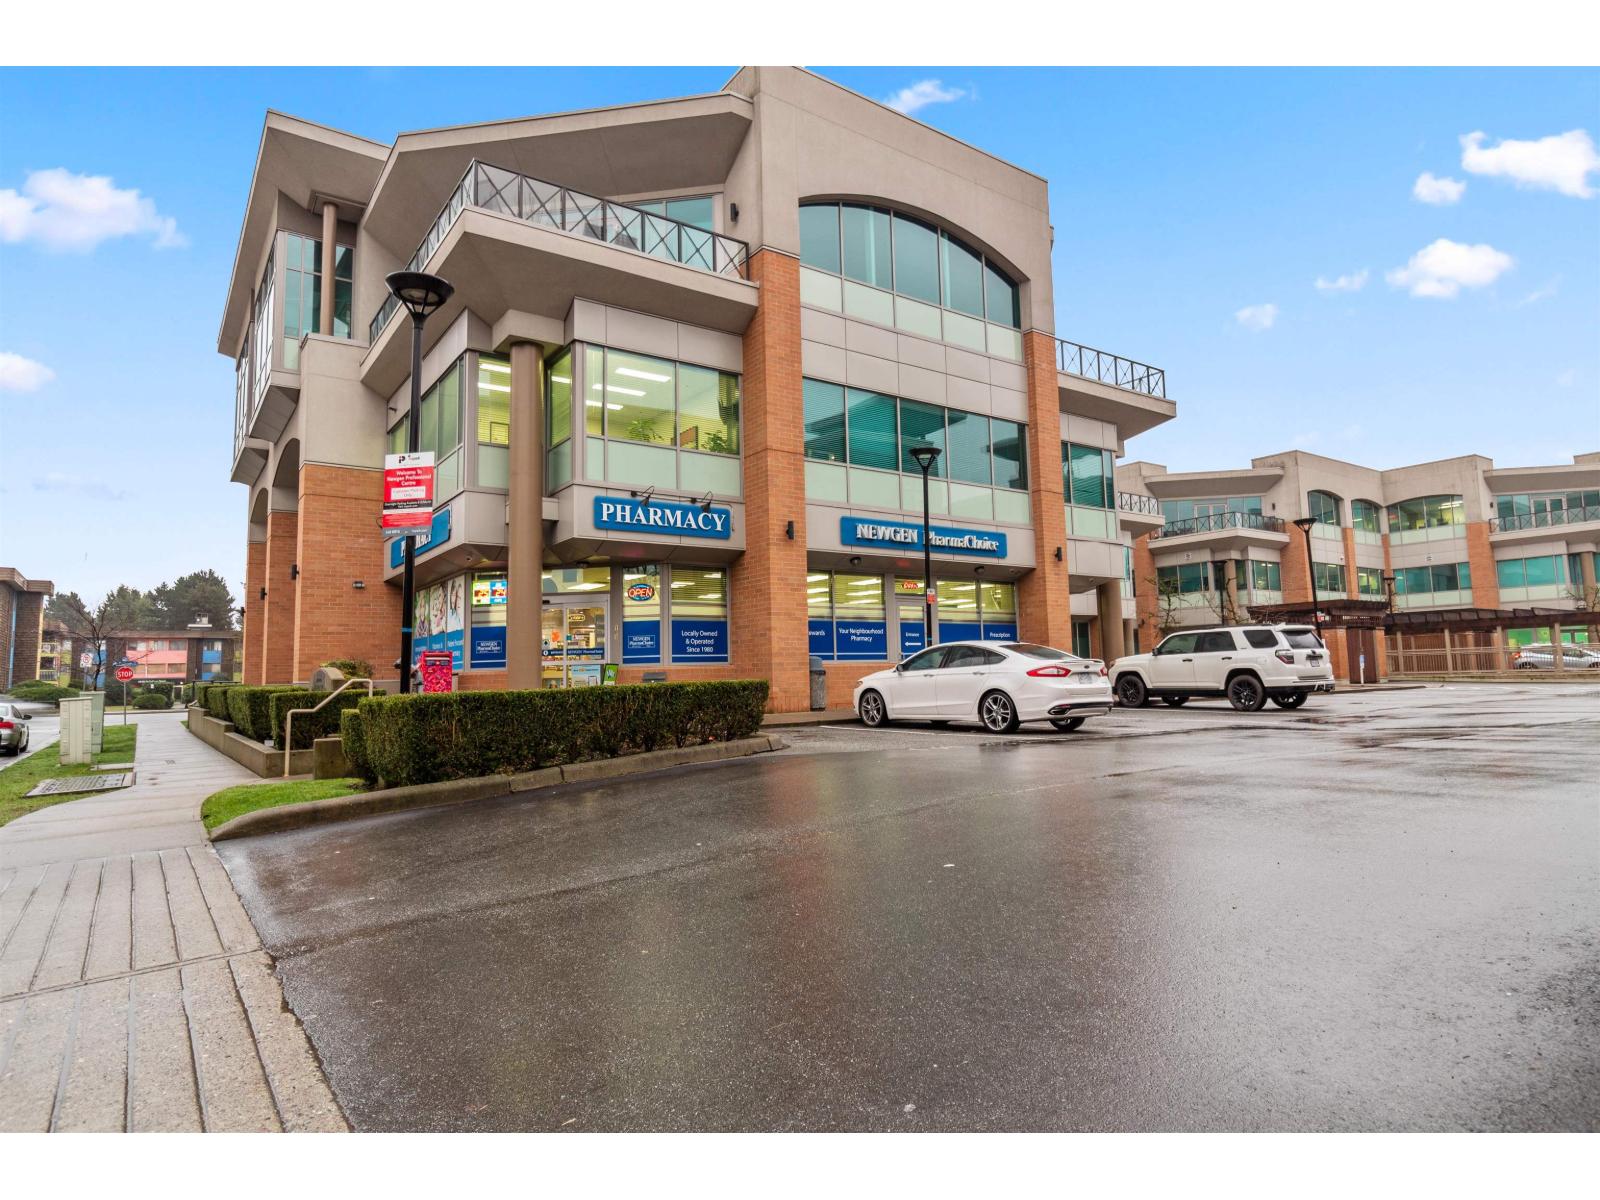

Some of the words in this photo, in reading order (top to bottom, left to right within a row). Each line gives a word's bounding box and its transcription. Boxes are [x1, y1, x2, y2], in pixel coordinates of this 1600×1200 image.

[600, 502, 727, 532] PHARMACY
[856, 523, 918, 543] NEWGEN
[628, 587, 653, 598] OPEN
[681, 630, 699, 638] Locally
[849, 628, 884, 636] Neighbourhood
[690, 638, 715, 646] Operated
